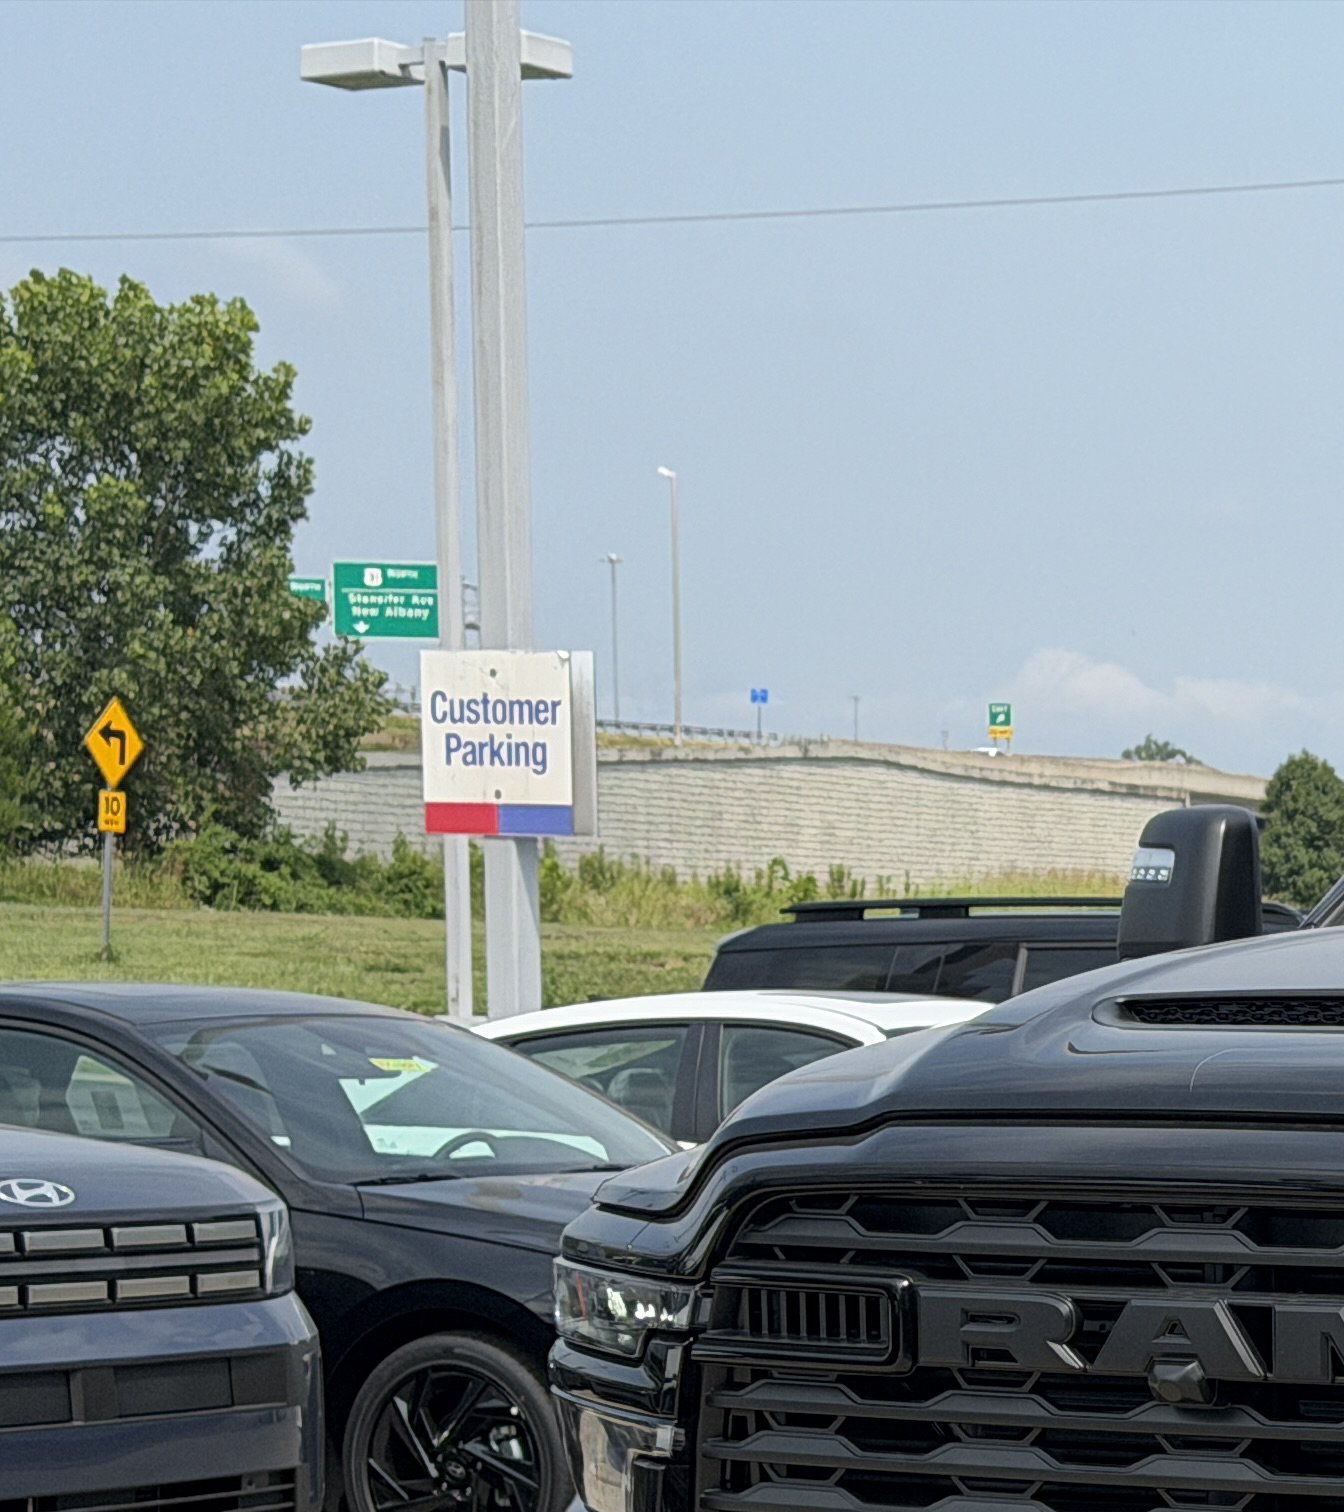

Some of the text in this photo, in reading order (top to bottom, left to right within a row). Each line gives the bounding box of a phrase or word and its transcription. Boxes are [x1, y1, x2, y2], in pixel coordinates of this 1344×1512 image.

[352, 605, 430, 621] New Albany
[430, 689, 562, 725] Customer
[445, 732, 548, 776] Parking
[105, 796, 121, 817] 10
